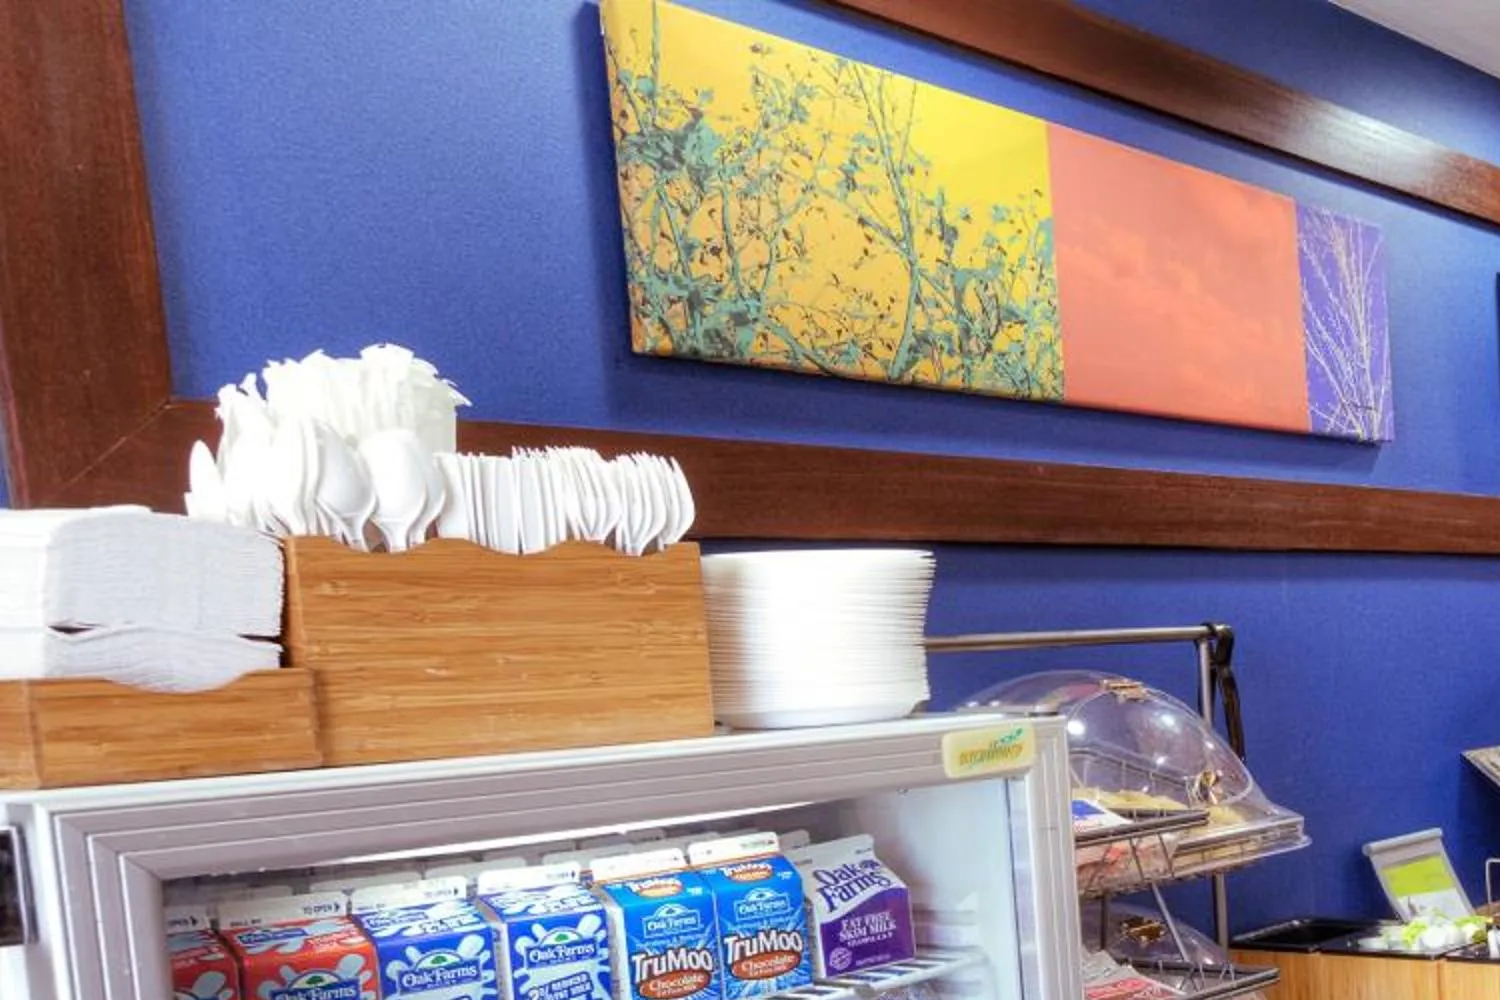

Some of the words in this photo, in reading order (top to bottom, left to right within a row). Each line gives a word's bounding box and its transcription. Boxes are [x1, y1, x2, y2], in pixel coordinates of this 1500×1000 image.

[812, 862, 861, 888] Oak
[816, 870, 892, 912] Farms
[724, 929, 803, 965] TruMoo
[403, 970, 434, 988] Oak
[435, 964, 477, 981] Farms
[632, 948, 713, 984] TruMoo
[305, 983, 357, 1000] Farms
